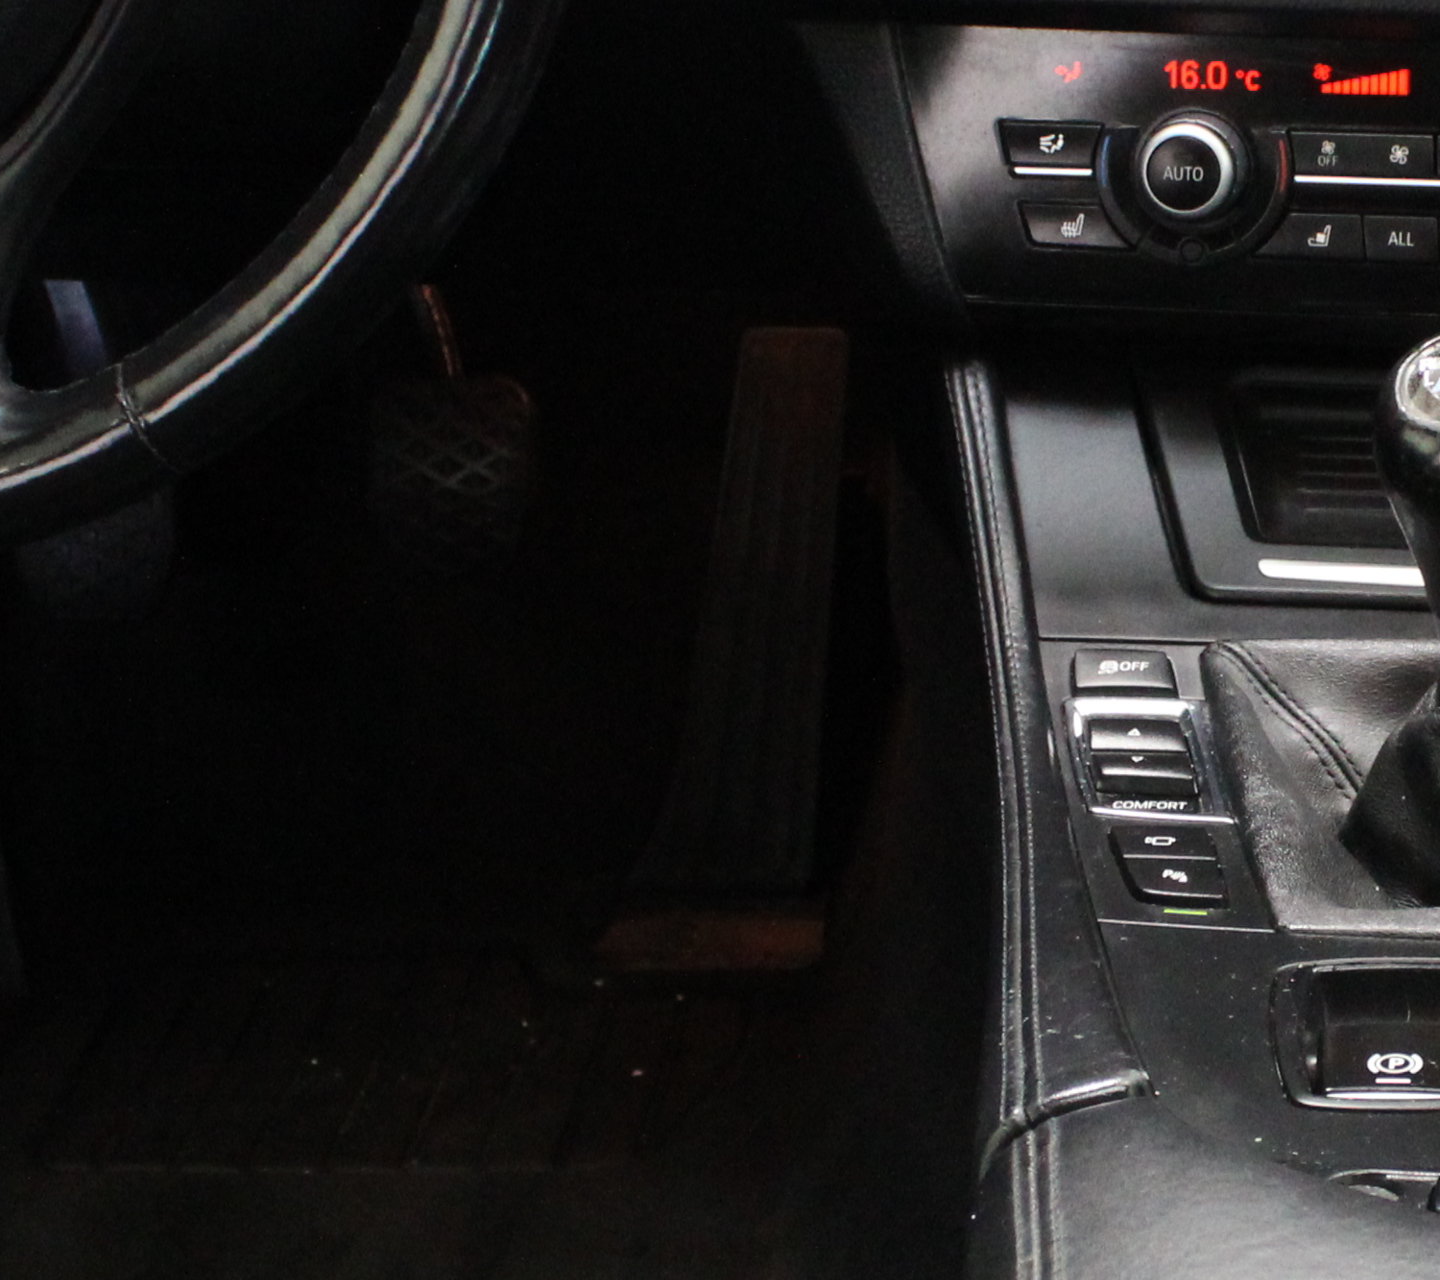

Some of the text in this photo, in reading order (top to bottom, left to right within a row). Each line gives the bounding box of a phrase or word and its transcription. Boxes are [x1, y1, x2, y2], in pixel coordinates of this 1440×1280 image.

[1163, 59, 1261, 91] 16.0 °C
[1317, 153, 1339, 167] OFF
[1162, 165, 1204, 182] AUTO
[1388, 231, 1414, 247] ALL
[1119, 660, 1149, 672] OFF
[1112, 800, 1188, 811] COMFORT
